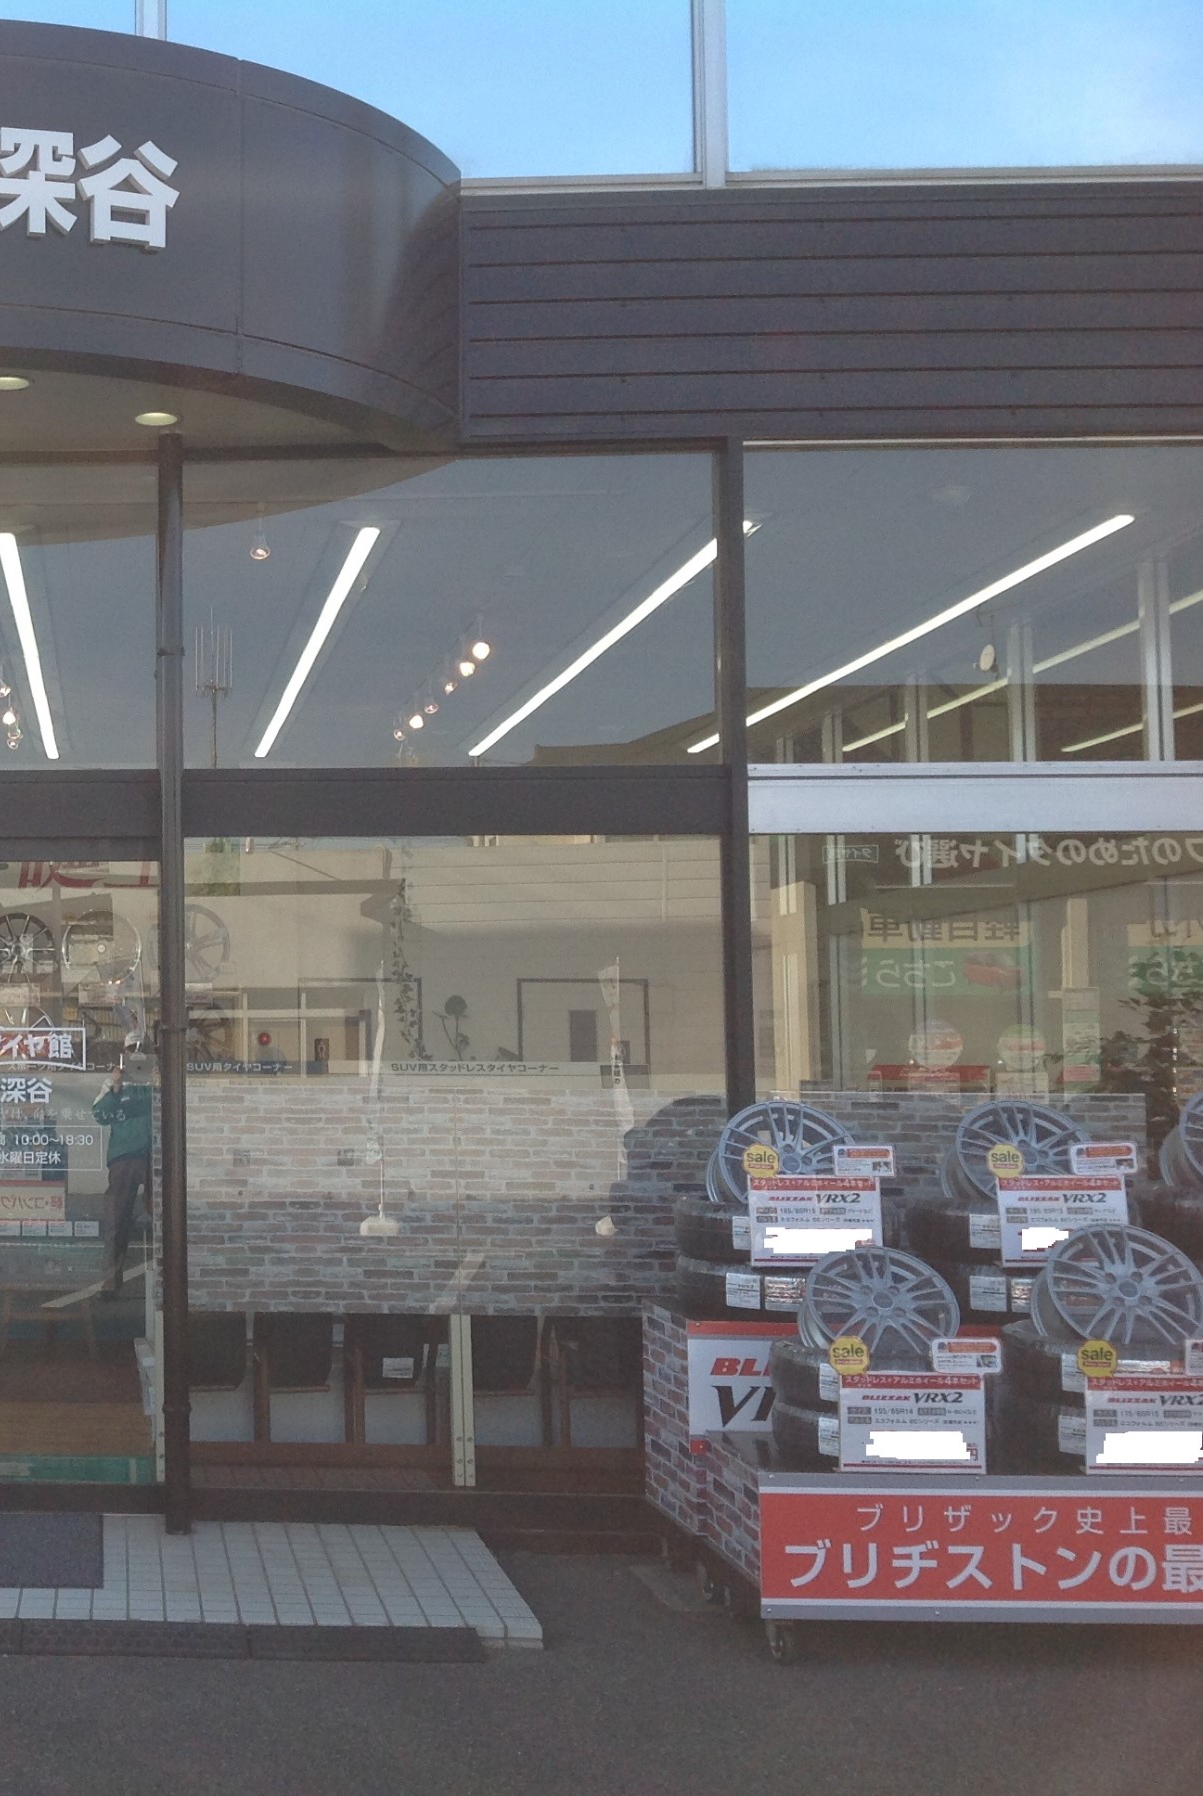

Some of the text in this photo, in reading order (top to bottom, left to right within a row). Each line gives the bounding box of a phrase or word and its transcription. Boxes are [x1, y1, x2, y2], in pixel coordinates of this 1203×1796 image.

[0, 1077, 53, 1104] 深谷
[746, 1151, 775, 1163] sale
[991, 1151, 1020, 1163] sale
[816, 1193, 861, 1204] VRX2
[1063, 1193, 1107, 1203] VRX2
[832, 1344, 864, 1358] sale
[1081, 1347, 1113, 1360] sale
[914, 1391, 964, 1403] VRX2
[857, 1504, 1193, 1536] ブリザック史上最
[785, 1539, 1203, 1592] ブリヂストンの最
